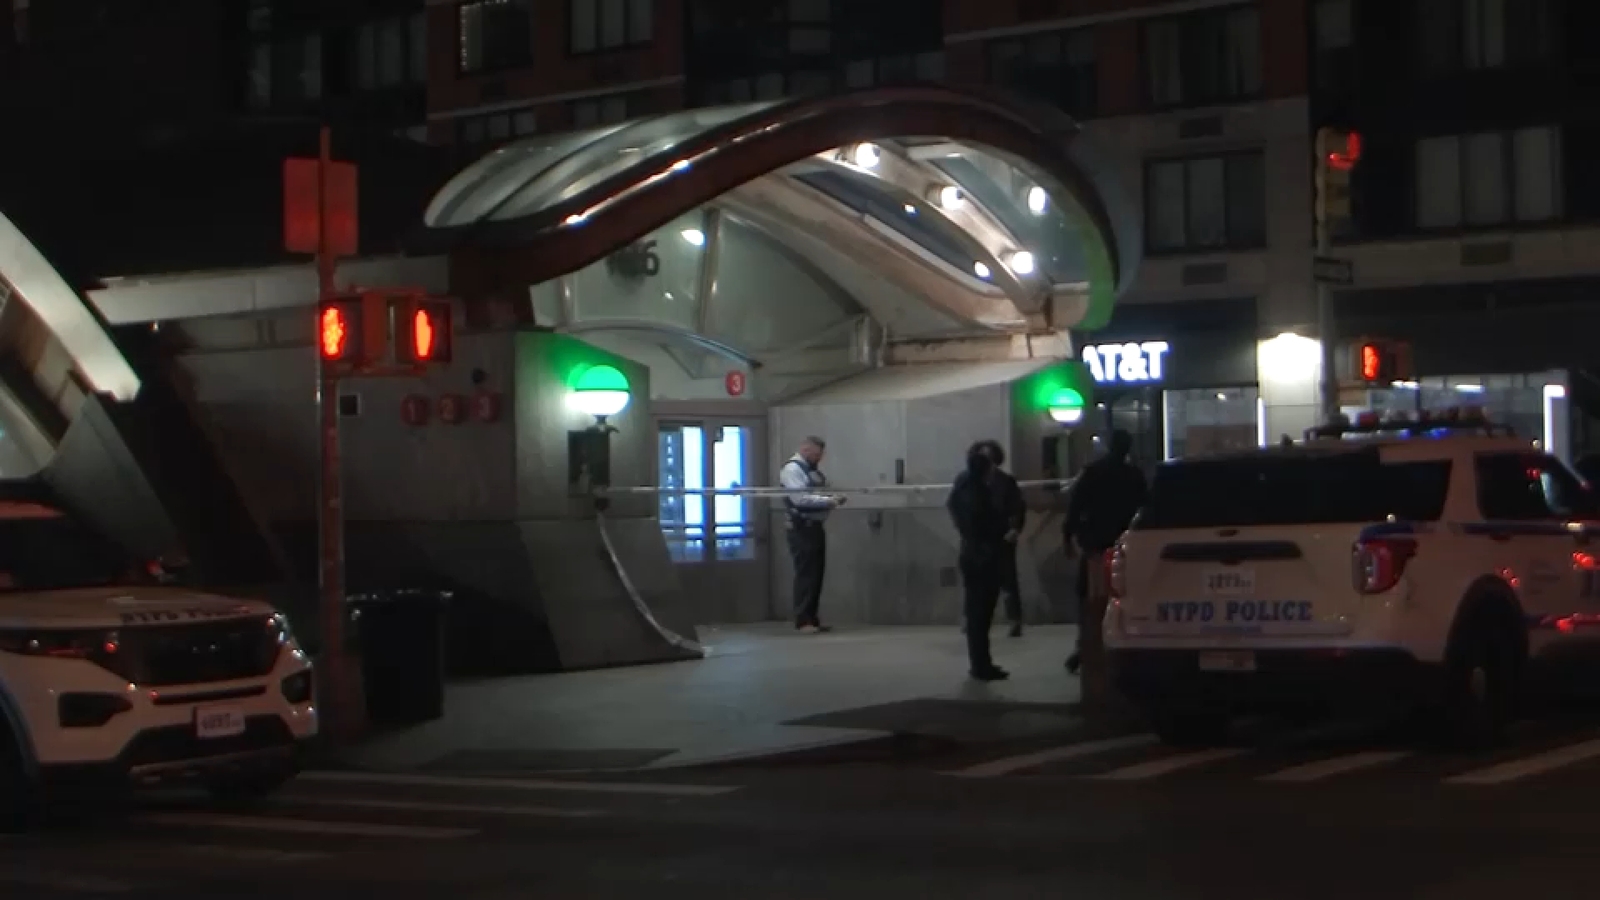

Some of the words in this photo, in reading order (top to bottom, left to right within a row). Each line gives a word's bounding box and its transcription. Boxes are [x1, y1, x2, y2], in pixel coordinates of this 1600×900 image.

[1082, 341, 1169, 382] AT&T
[1156, 600, 1214, 623] NYPD
[1225, 600, 1314, 623] POLICE
